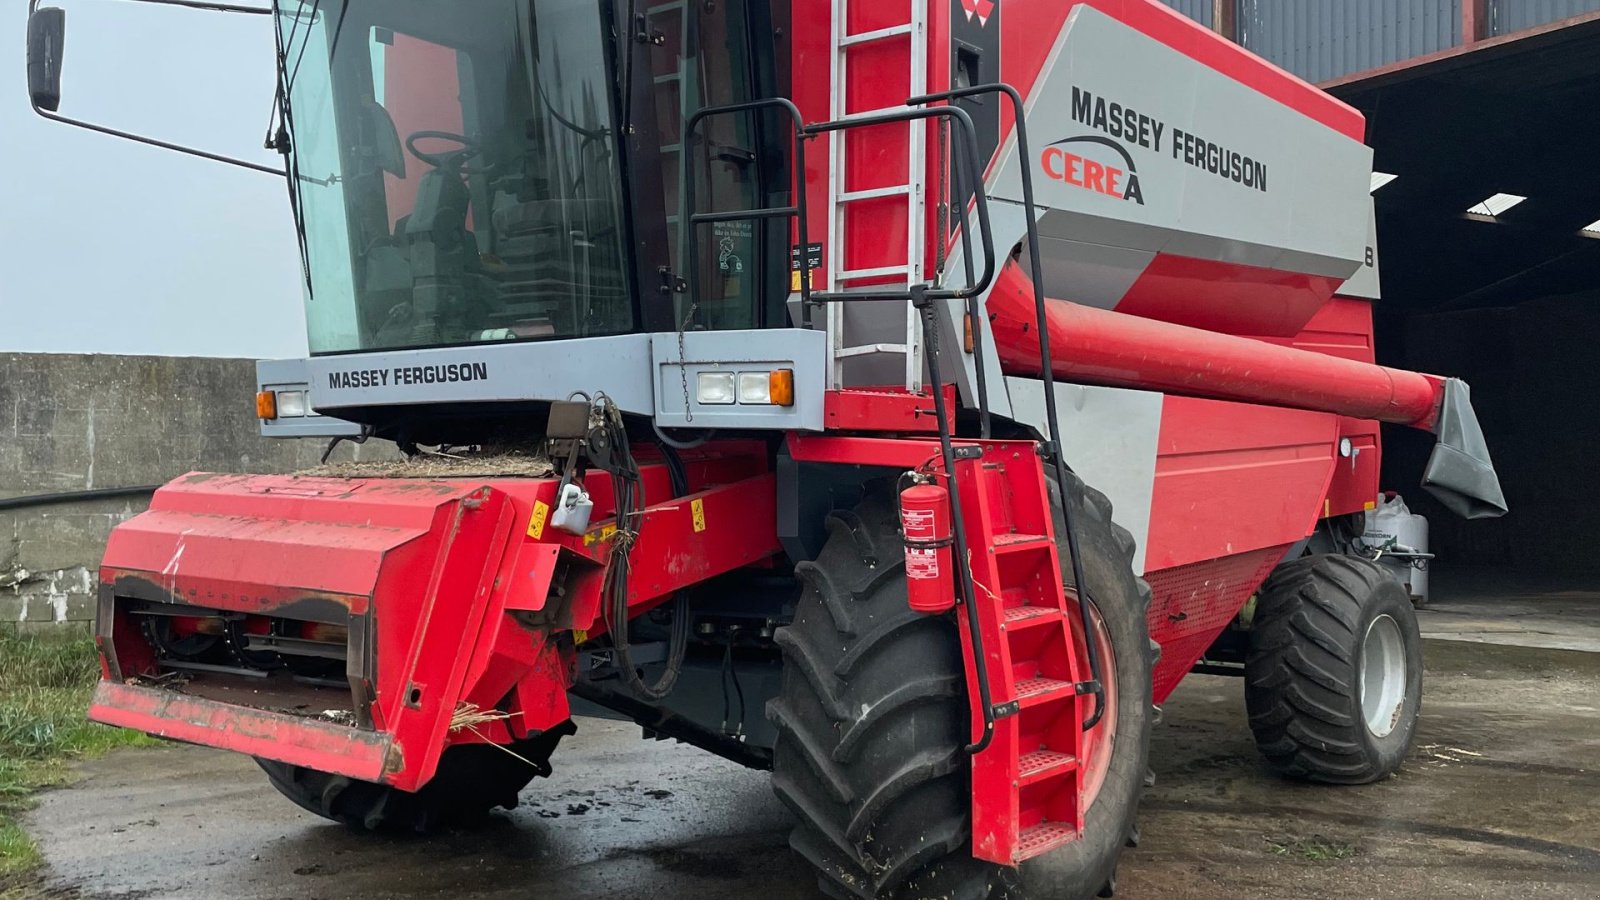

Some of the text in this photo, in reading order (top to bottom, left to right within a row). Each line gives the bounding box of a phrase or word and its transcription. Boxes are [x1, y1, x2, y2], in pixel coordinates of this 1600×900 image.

[1071, 85, 1267, 192] MASSEY FERGUSON
[1041, 147, 1145, 205] CEREA
[1365, 246, 1373, 268] 8
[328, 362, 488, 389] MASSEY FERGUSON
